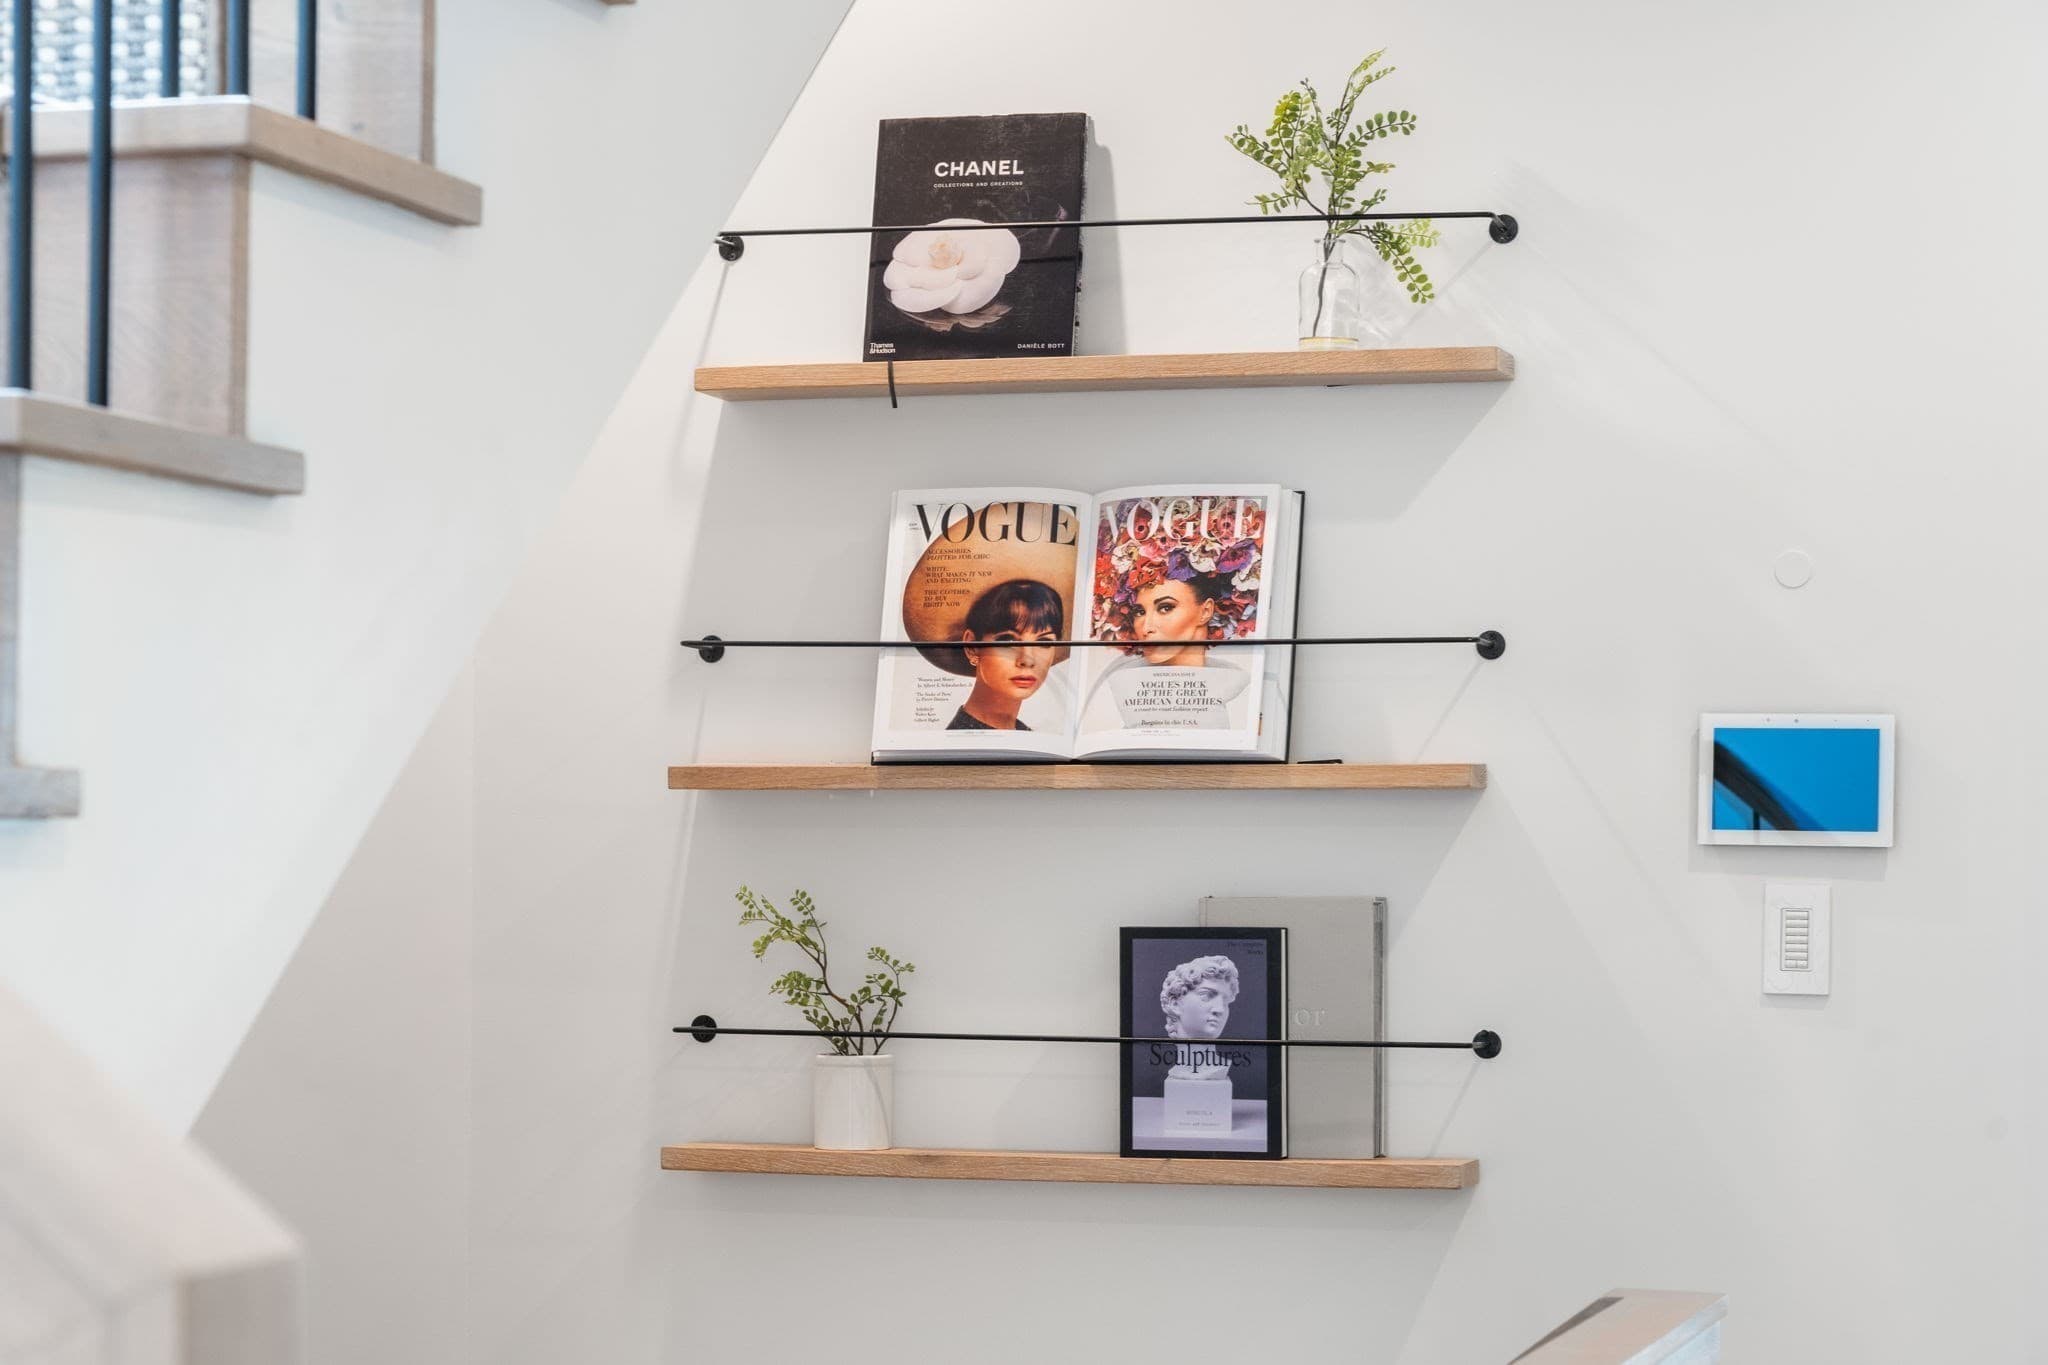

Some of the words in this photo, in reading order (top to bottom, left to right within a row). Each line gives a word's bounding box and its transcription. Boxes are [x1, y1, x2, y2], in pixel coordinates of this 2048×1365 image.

[934, 160, 1025, 177] CHANEL
[912, 501, 1077, 546] VOGUE
[1102, 498, 1263, 543] VOGUE
[1183, 680, 1207, 688] PICK
[1124, 698, 1172, 706] AMERICAN
[1175, 697, 1224, 705] CLOTHES
[1136, 689, 1151, 697] OF
[1152, 689, 1173, 697] THE
[1176, 689, 1209, 697] GREAT
[1149, 1042, 1252, 1073] Sculptures
